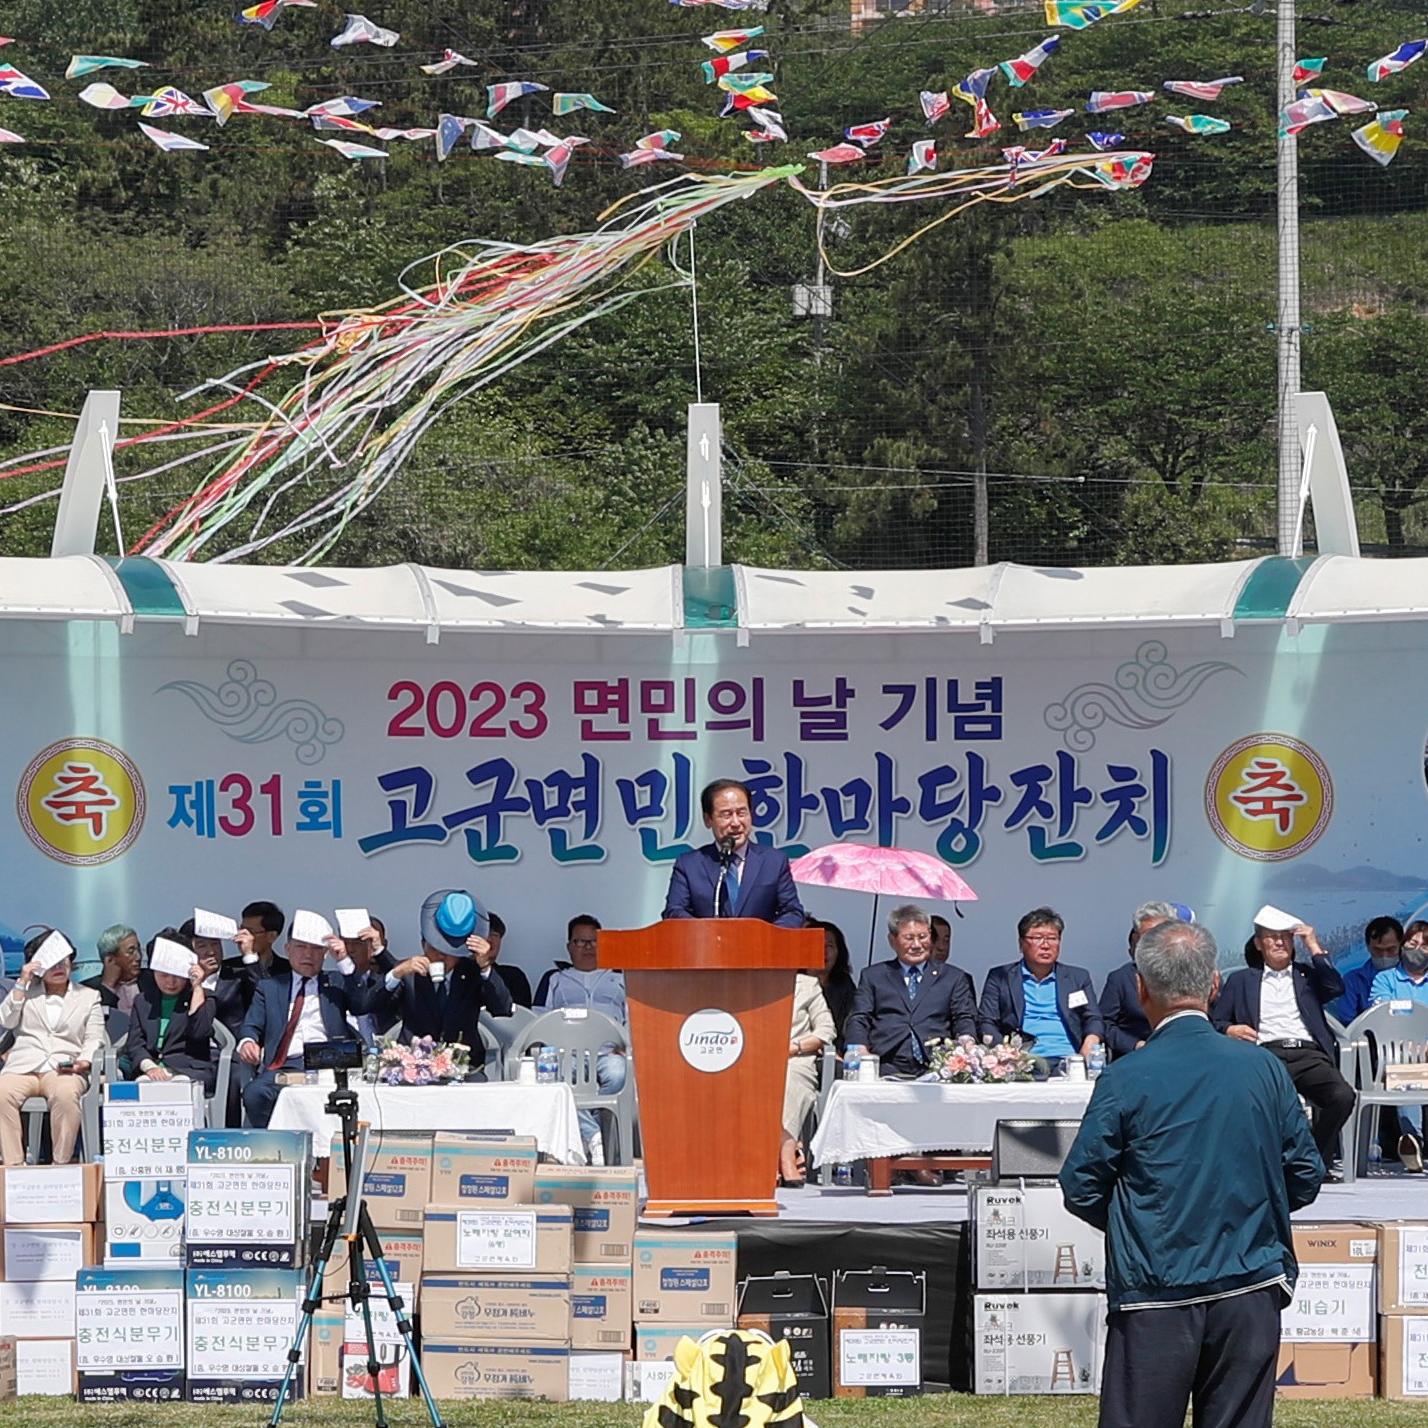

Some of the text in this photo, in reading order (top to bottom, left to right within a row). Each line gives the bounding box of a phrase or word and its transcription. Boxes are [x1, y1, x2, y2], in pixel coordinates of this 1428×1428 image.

[387, 676, 1003, 742] 2023 면민의 날 기념
[40, 760, 122, 840] 축
[1230, 755, 1307, 836] 축
[167, 748, 1173, 866] 제31회 고군면민 한마당잔치
[685, 1033, 729, 1046] Jindo
[195, 1146, 252, 1160] YL-8100
[986, 1196, 1022, 1204] Ruvek
[189, 1200, 289, 1217] 충전식분무기
[986, 1228, 1049, 1241] 좌석용 선풍기
[1307, 1240, 1337, 1248] WINIX
[194, 1284, 252, 1297] YL-8100
[983, 1302, 1020, 1310] Ruvek
[1297, 1299, 1346, 1316] 제습기
[78, 1326, 178, 1343] 충전식분무기
[1016, 1334, 1046, 1346] 선풍기
[194, 1336, 295, 1352] 충전식분무기
